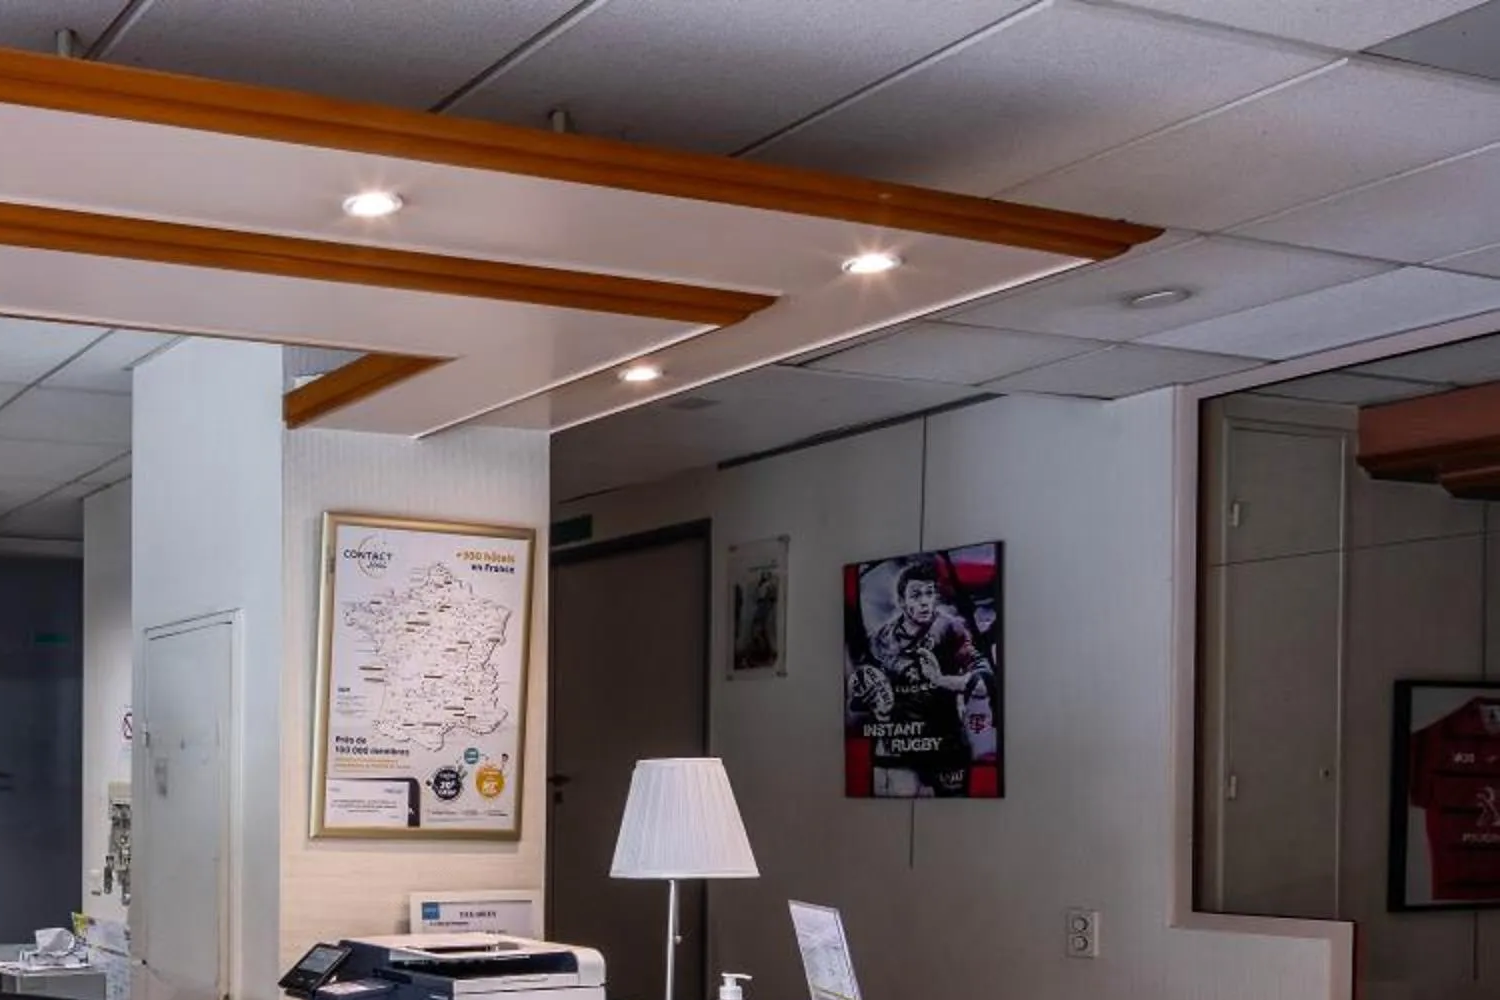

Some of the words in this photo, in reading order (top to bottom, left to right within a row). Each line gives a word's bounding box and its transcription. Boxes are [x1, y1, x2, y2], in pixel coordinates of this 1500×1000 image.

[343, 548, 393, 561] CONTACT
[484, 563, 515, 574] France
[863, 721, 925, 737] INSTANT
[891, 737, 944, 752] RUGBY
